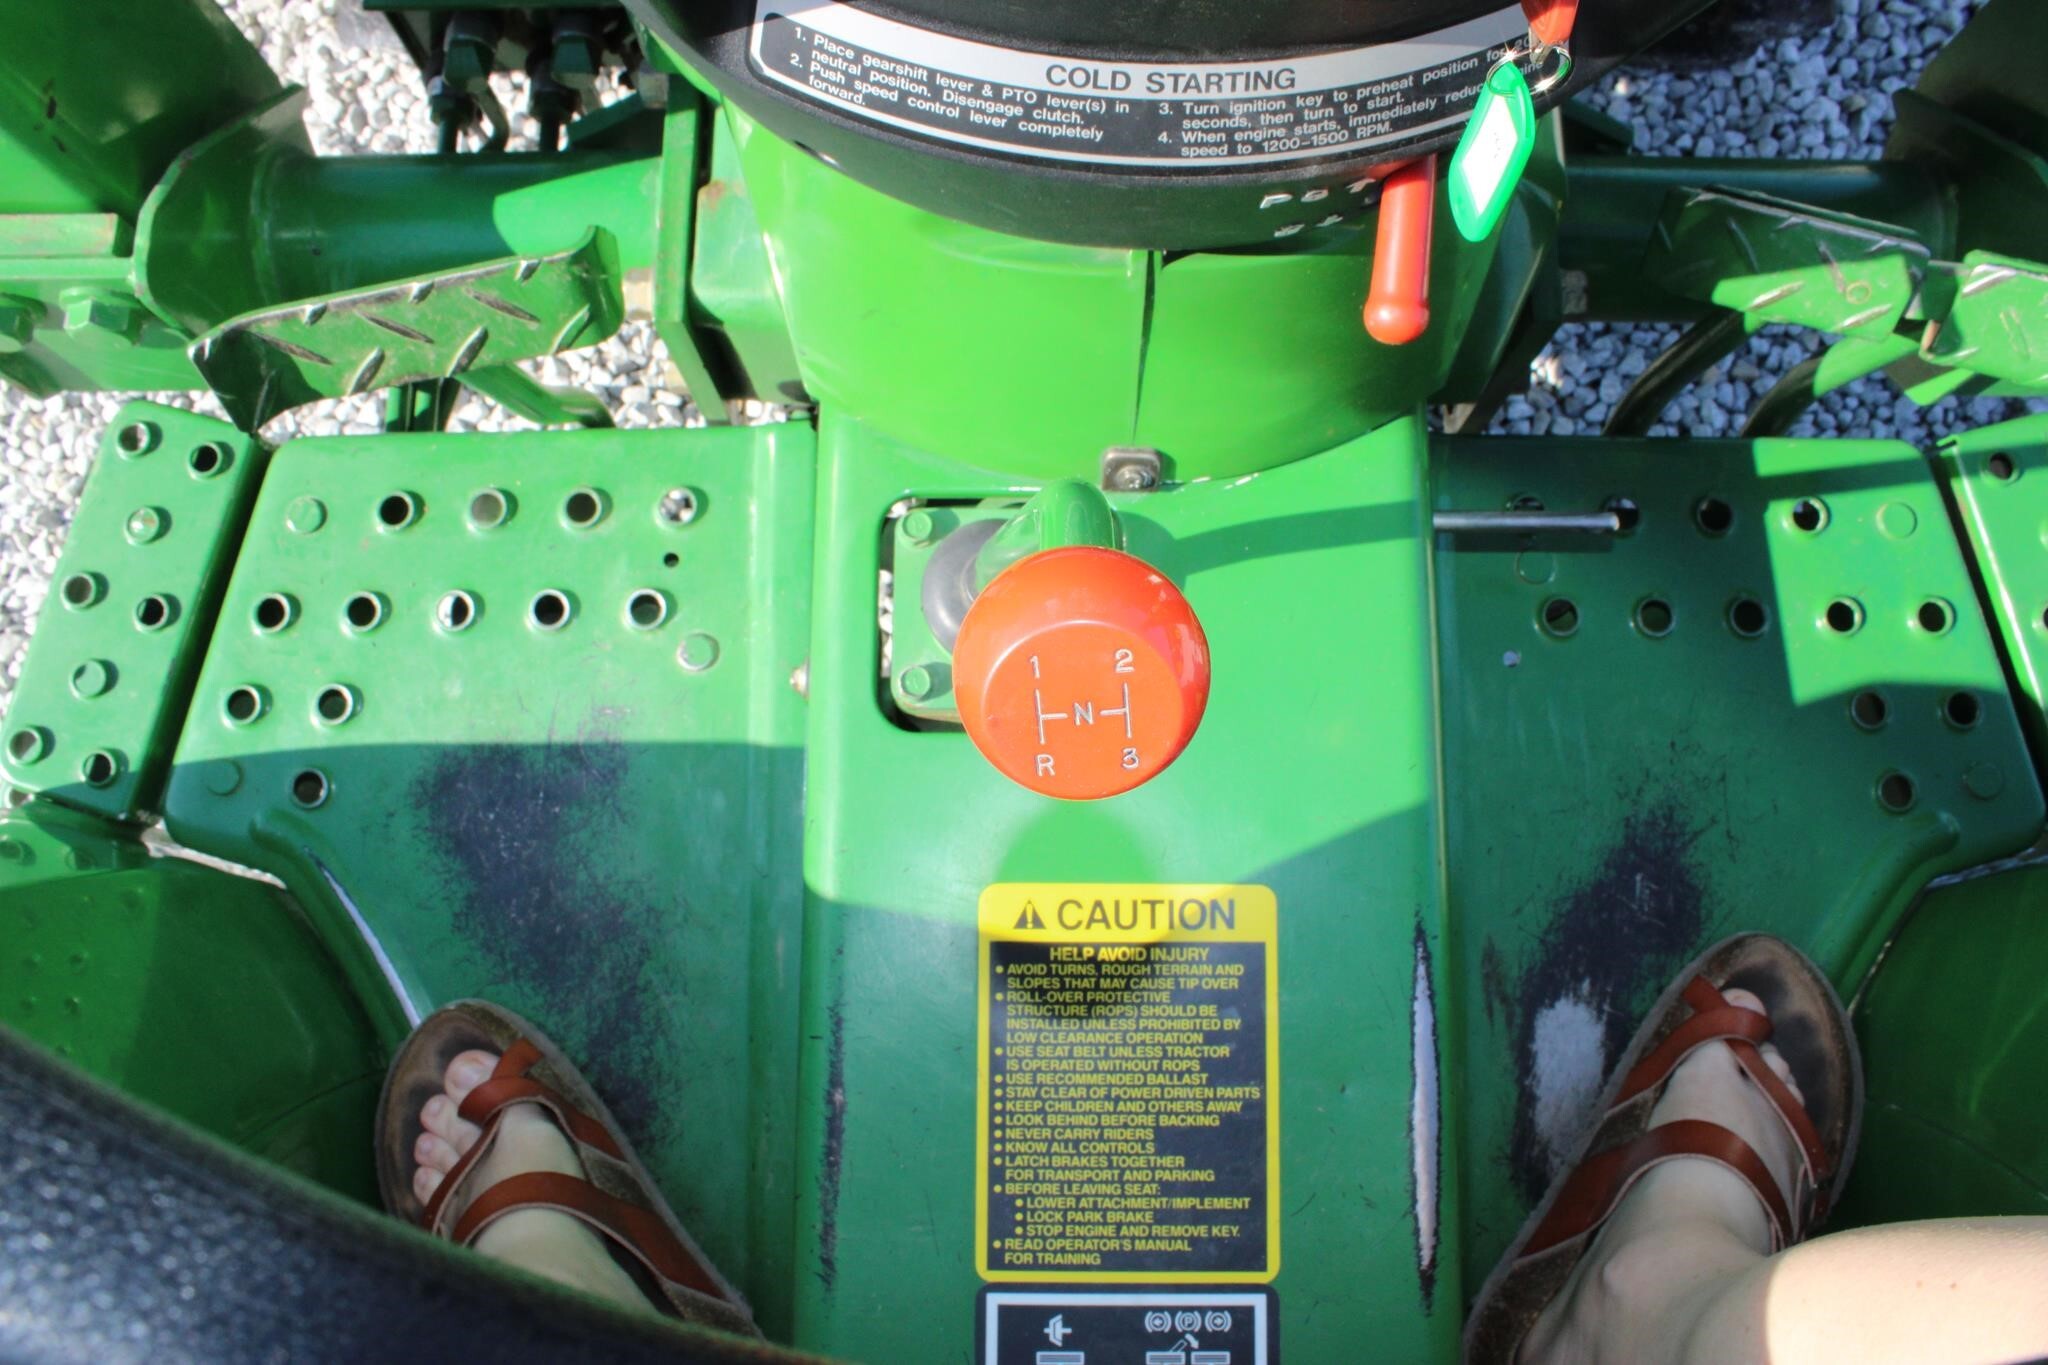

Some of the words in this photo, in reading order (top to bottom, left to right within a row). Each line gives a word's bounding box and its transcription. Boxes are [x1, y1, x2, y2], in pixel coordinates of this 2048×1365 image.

[794, 27, 806, 42] 1.
[814, 34, 855, 59] Place
[863, 53, 928, 82] gearshift
[935, 73, 974, 92] lever
[981, 84, 993, 98] &
[1002, 87, 1038, 104] PTO
[1047, 94, 1107, 114] lever(s)
[1115, 100, 1130, 113] in
[1046, 64, 1131, 91] COLD
[1145, 68, 1296, 94] STARTING
[808, 74, 866, 106] forward.
[811, 49, 862, 76] neutral
[870, 71, 931, 97] position.
[942, 89, 1024, 117] Disengage
[1032, 108, 1084, 125] clutch.
[1159, 102, 1173, 115] 3.
[1182, 102, 1219, 115] Turn
[1229, 99, 1286, 117] ignition
[1296, 94, 1323, 108] key
[1333, 90, 1348, 102] to
[1356, 75, 1414, 101] preheat
[1422, 56, 1479, 85] position
[790, 53, 803, 68] 2.
[809, 61, 846, 85] Push
[853, 78, 898, 102] speed
[908, 96, 960, 118] control
[970, 110, 1007, 128] lever
[1018, 121, 1104, 142] completely
[1157, 131, 1172, 144] 4.
[1182, 130, 1226, 143] When
[1234, 125, 1286, 142] engine
[1294, 119, 1341, 136] starts,
[1348, 97, 1437, 127] immediately
[1445, 82, 1483, 104] reduc
[1182, 115, 1252, 130] seconds,
[1260, 111, 1294, 125] then
[1304, 106, 1334, 120] turn
[1343, 102, 1358, 113] to
[1367, 92, 1405, 110] start.
[1181, 144, 1228, 158] speed
[1237, 143, 1252, 154] to
[1356, 124, 1393, 139] RPM.
[1114, 648, 1135, 673] 2
[1030, 655, 1040, 679] 1
[1073, 701, 1094, 726] N
[1121, 747, 1140, 769] 3
[1036, 753, 1056, 777] R
[1058, 899, 1234, 930] CAUTION
[1050, 947, 1094, 961] HELP
[1098, 947, 1146, 961] AVOID
[1151, 947, 1209, 961] INJURY
[1008, 965, 1047, 975] AVOID
[1052, 965, 1097, 975] TURNS,
[1101, 965, 1150, 975] ROUGH
[1155, 965, 1212, 975] TERRAIN
[1216, 965, 1244, 975] AND
[1008, 978, 1060, 989] SLOPES
[1064, 978, 1095, 989] THAT
[1099, 978, 1126, 989] MAY
[1130, 978, 1174, 989] CAUSE
[1179, 978, 1199, 989] TIP
[1203, 978, 1238, 989] OVER
[1007, 992, 1083, 1002] ROLL-OVER
[1087, 992, 1170, 1002] PROTECTIVE
[1008, 1005, 1087, 1017] STRUCTURE
[1092, 1005, 1137, 1017] (ROPS)
[1141, 1005, 1195, 1017] SHOULD
[1200, 1005, 1217, 1017] BE
[1007, 1019, 1079, 1030] INSTALLED
[1083, 1019, 1135, 1030] UNLESS
[1140, 1019, 1219, 1030] PROHIBITED
[1224, 1019, 1240, 1030] BY
[1007, 1033, 1036, 1043] LOW
[1040, 1033, 1122, 1043] CLEARANCE
[1127, 1033, 1203, 1043] OPERATION
[1007, 1046, 1033, 1057] USE
[1037, 1046, 1070, 1057] SEAT
[1074, 1046, 1106, 1057] BELT
[1110, 1046, 1163, 1057] UNLESS
[1167, 1046, 1230, 1057] TRACTOR
[1007, 1060, 1018, 1071] IS
[1022, 1060, 1094, 1071] OPERATED
[1098, 1060, 1159, 1071] WITHOUT
[1163, 1060, 1200, 1071] ROPS
[1007, 1074, 1033, 1084] USE
[1037, 1074, 1143, 1084] RECOMMENDED
[1147, 1074, 1208, 1084] BALLAST
[1007, 1088, 1037, 1098] STAY
[1041, 1088, 1086, 1098] CLEAR
[1090, 1088, 1107, 1098] OF
[1111, 1088, 1160, 1098] POWER
[1164, 1088, 1214, 1098] DRIVEN
[1217, 1088, 1260, 1098] PARTS
[1006, 1101, 1041, 1112] KEEP
[1045, 1101, 1113, 1112] CHILDREN
[1117, 1101, 1145, 1112] AND
[1149, 1101, 1203, 1112] OTHERS
[1207, 1101, 1242, 1112] AWAY
[1006, 1115, 1044, 1126] LOOK
[1048, 1115, 1097, 1126] BEHIND
[1101, 1115, 1156, 1126] BEFORE
[1160, 1115, 1219, 1126] BACKING
[1006, 1129, 1051, 1140] NEVER
[1055, 1129, 1100, 1140] CARRY
[1104, 1129, 1153, 1140] RIDERS
[1006, 1143, 1047, 1153] KNOW
[1051, 1143, 1076, 1153] ALL
[1080, 1143, 1155, 1153] CONTROLS
[1006, 1157, 1049, 1167] LATCH
[1052, 1157, 1108, 1167] BRAKES
[1111, 1157, 1185, 1167] TOGETHER
[1005, 1170, 1033, 1181] FOR
[1037, 1170, 1119, 1181] TRANSPORT
[1123, 1170, 1151, 1181] AND
[1156, 1170, 1215, 1181] PARKING
[1006, 1184, 1060, 1195] BEFORE
[1064, 1184, 1120, 1195] LEAVING
[1124, 1184, 1160, 1195] SEAT:
[1027, 1198, 1075, 1209] LOWER
[1078, 1198, 1250, 1209] ATTACHMENT/IMPLEMENT
[1027, 1212, 1063, 1222] LOCK
[1067, 1212, 1103, 1222] PARK
[1107, 1212, 1153, 1222] BRAKE
[1027, 1226, 1062, 1237] STOP
[1066, 1226, 1116, 1237] ENGINE
[1120, 1226, 1148, 1237] AND
[1152, 1226, 1208, 1237] REMOVE
[1212, 1226, 1240, 1237] KEY.
[1005, 1239, 1042, 1251] READ
[1046, 1239, 1131, 1251] OPERATOR'S
[1135, 1239, 1191, 1251] MANUAL
[1005, 1254, 1033, 1265] FOR
[1037, 1254, 1100, 1265] TRAINING
